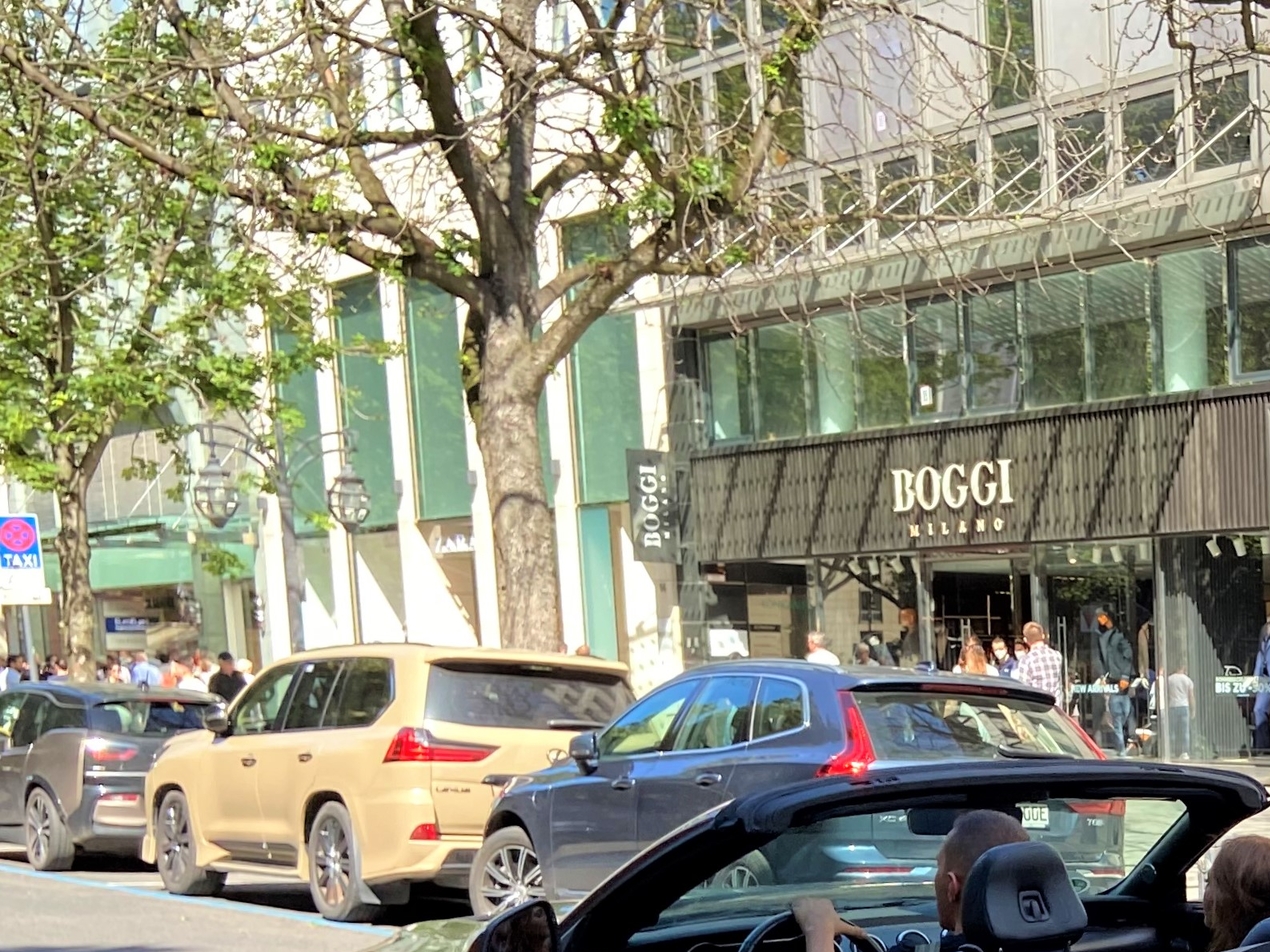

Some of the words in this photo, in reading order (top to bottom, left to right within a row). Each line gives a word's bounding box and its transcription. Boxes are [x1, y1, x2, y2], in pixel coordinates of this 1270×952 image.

[890, 458, 1014, 513] BOGGI
[639, 464, 662, 548] BOGGI
[908, 517, 1005, 538] MILANO
[3, 553, 39, 568] TAXI
[1215, 682, 1231, 694] BIS
